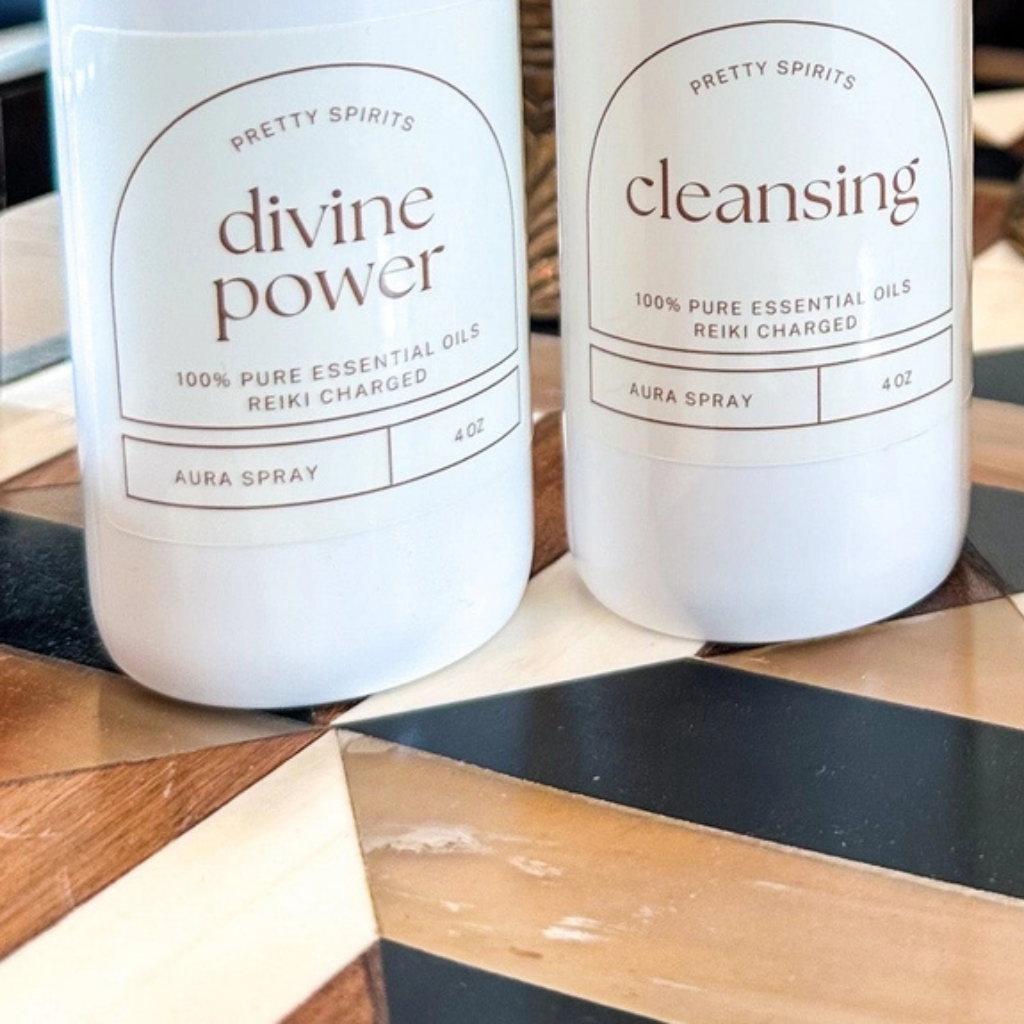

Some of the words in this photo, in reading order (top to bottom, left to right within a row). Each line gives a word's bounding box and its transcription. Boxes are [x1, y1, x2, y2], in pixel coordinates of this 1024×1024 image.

[689, 60, 768, 95] PRETTY
[777, 60, 857, 91] SPIRITS
[230, 108, 318, 153] PRETTY
[328, 105, 416, 133] SPIRITS
[626, 157, 920, 227] cleansing
[218, 185, 435, 256] divine
[212, 244, 446, 342] power
[635, 292, 681, 314] 100%
[689, 299, 742, 316] PURE
[751, 291, 866, 316] ESSENTIAL
[873, 279, 912, 302] OILS
[694, 322, 749, 340] REIKI
[757, 315, 858, 339] CHARGED
[177, 371, 232, 389] 100%
[240, 368, 303, 388] PURE
[312, 340, 435, 382] ESSENTIAL
[442, 323, 481, 351] OILS
[248, 393, 310, 412] REIKI
[320, 368, 427, 406] CHARGED
[629, 382, 678, 404] AURA
[685, 391, 753, 409] SPRAY
[175, 469, 233, 487] AURA
[242, 465, 319, 487] SPRAY
